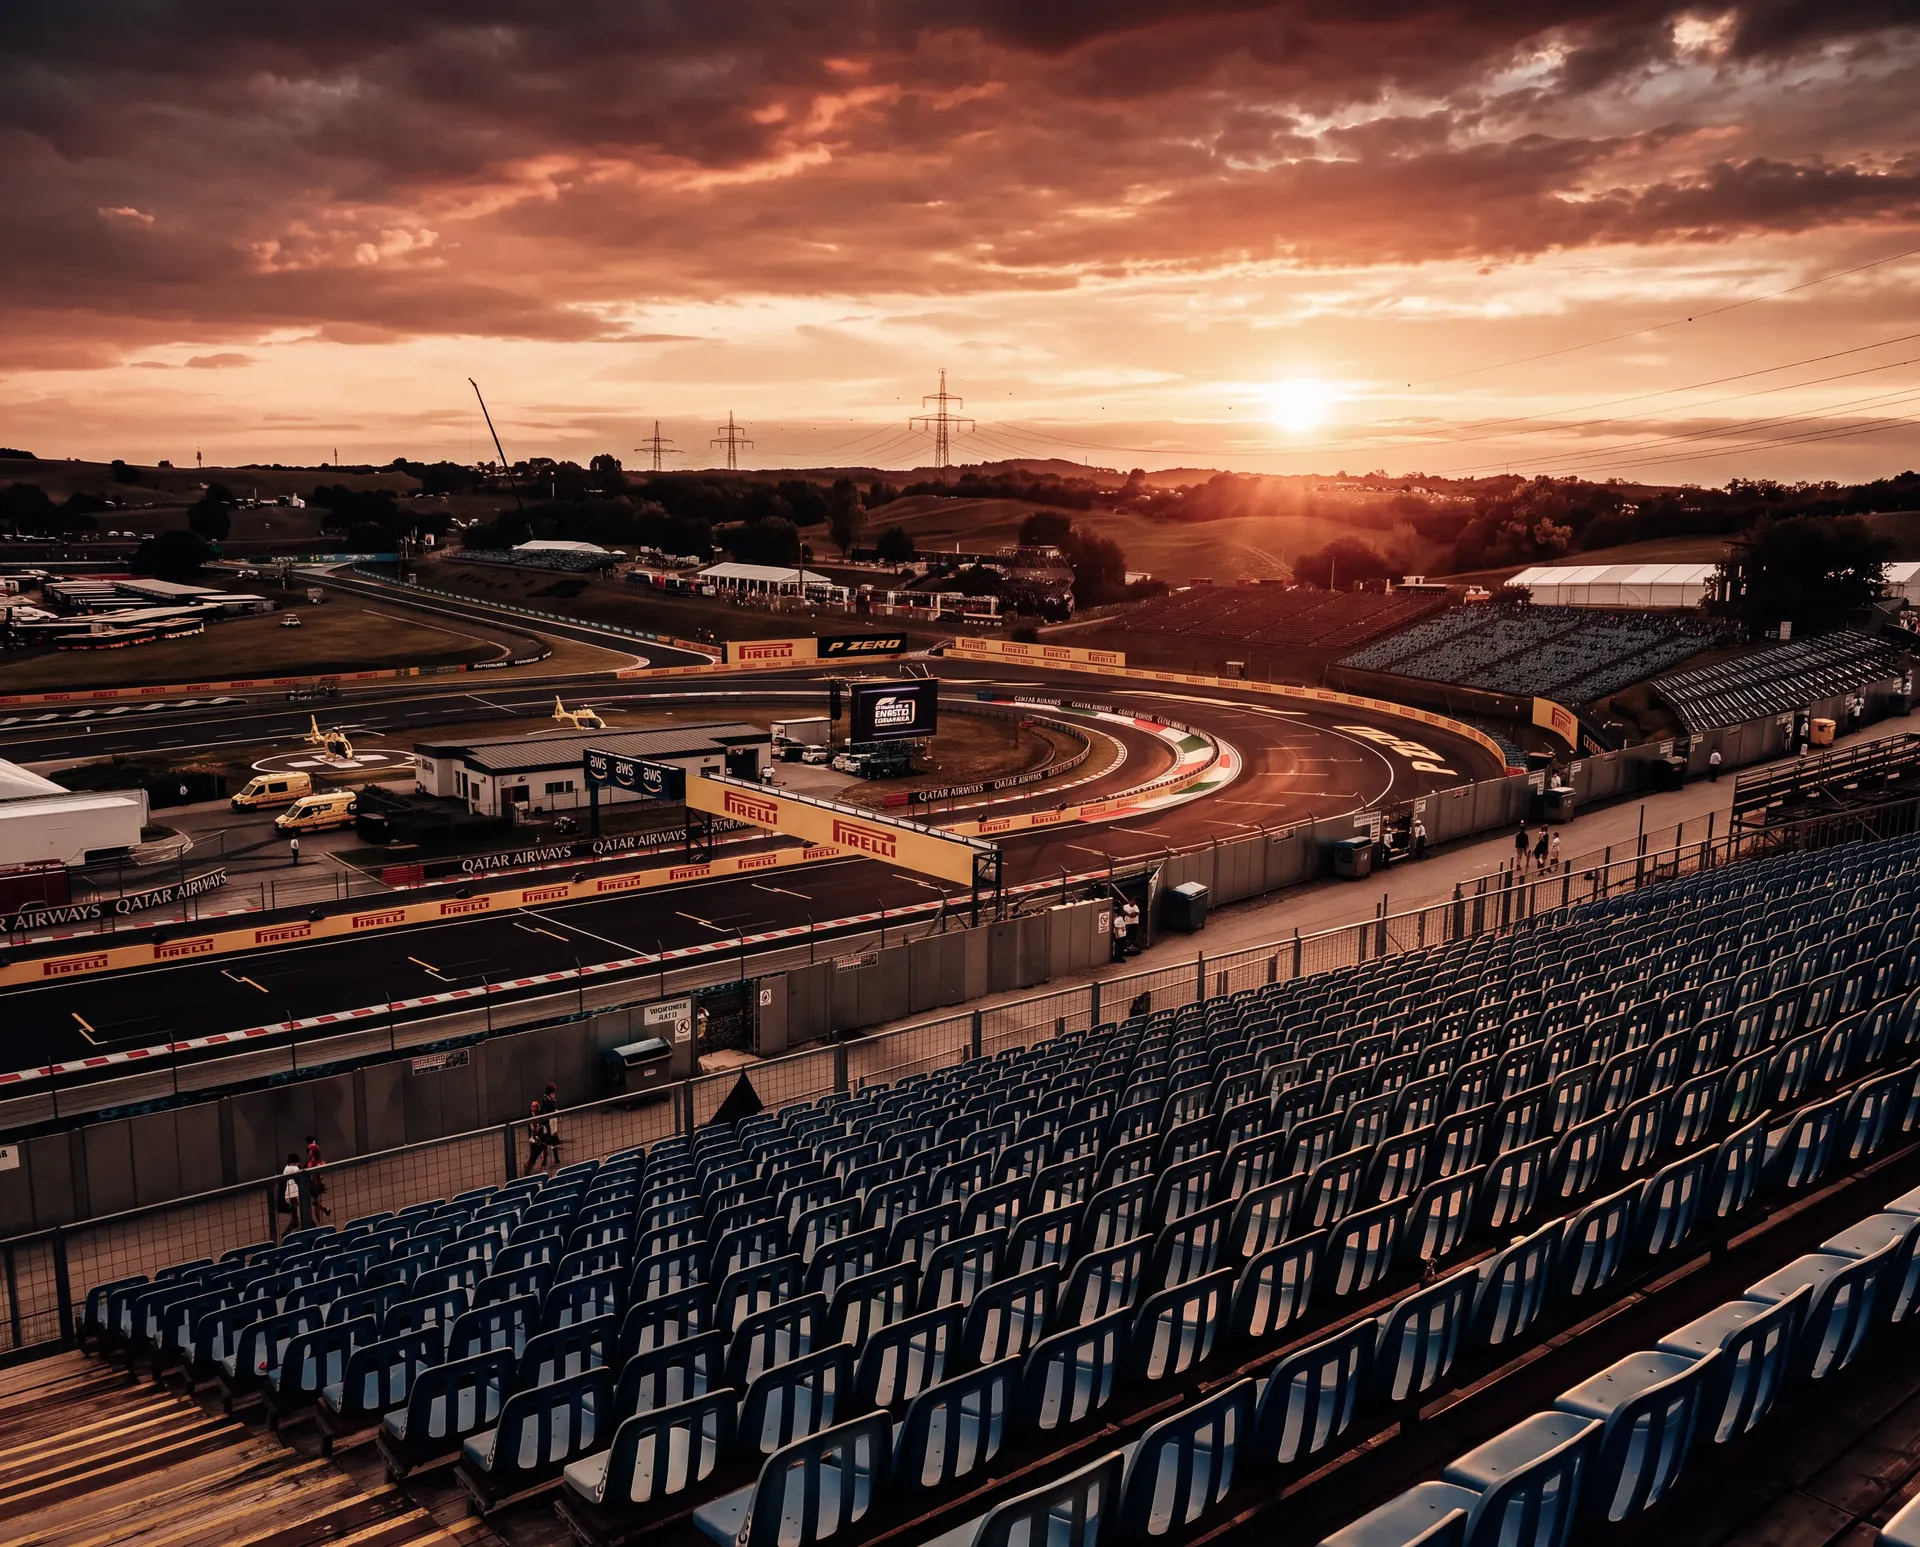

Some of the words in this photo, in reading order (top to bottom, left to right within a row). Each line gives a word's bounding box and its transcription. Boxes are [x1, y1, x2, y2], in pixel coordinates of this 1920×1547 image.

[739, 643, 793, 660] PIRELLI
[828, 641, 845, 652] P
[846, 639, 902, 651] ZERO
[590, 755, 607, 770] aws
[616, 761, 634, 776] aws
[643, 767, 662, 783] aws
[919, 788, 949, 802] QATAR
[724, 790, 778, 826] PIRELLI
[592, 837, 635, 854] QATAR
[639, 829, 687, 848] AIRWAYS
[833, 819, 897, 858] PIRELLI
[461, 855, 510, 873] QATAR
[513, 846, 572, 865] AIRWAYS
[670, 864, 710, 880] PIRELLI
[597, 875, 641, 891] PIRELLI
[115, 889, 173, 915] QATAR
[176, 870, 227, 899] AIRWAYS
[522, 885, 569, 903] PIRELLI
[440, 897, 490, 915] PIRELLI
[14, 903, 102, 930] AIRWAYS
[353, 910, 405, 928] PIRELLI
[255, 923, 311, 944] PIRELLI
[153, 939, 214, 959] PIRELLI
